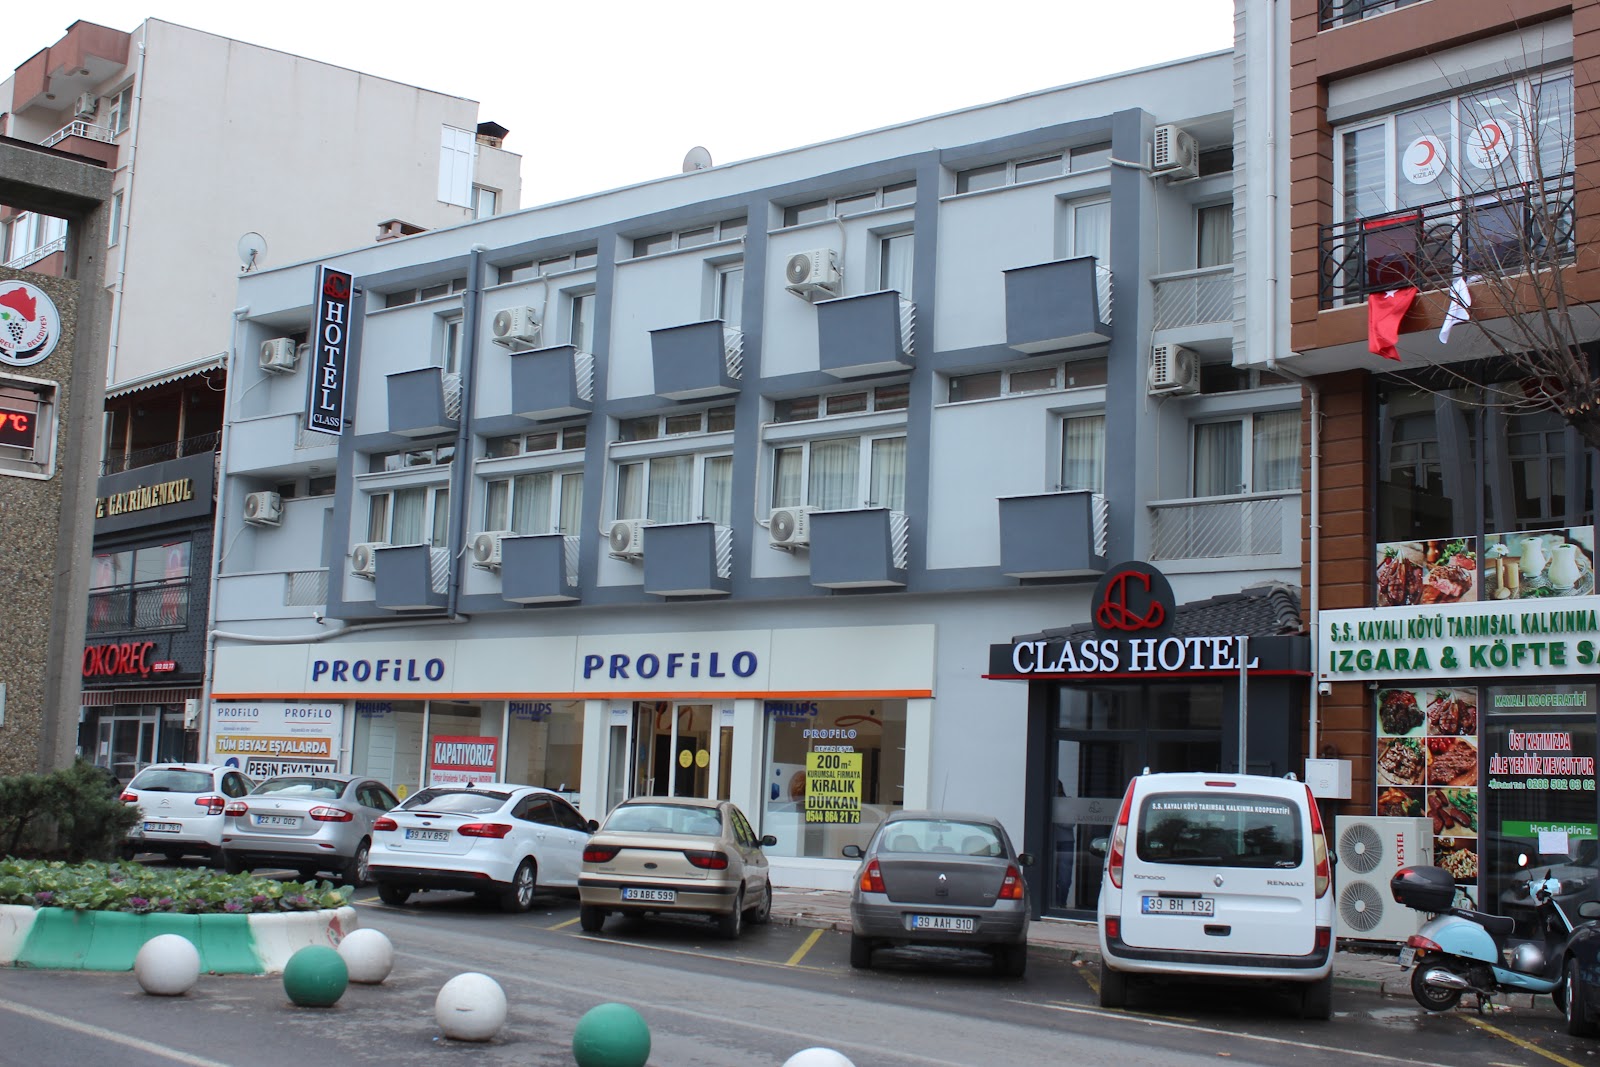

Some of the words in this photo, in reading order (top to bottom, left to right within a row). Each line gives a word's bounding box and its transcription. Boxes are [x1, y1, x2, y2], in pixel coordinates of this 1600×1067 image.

[320, 300, 345, 411] HOTEL
[313, 413, 340, 427] CLASS
[1330, 622, 1354, 642] S.S.
[1358, 619, 1404, 641] KAYALI
[1408, 614, 1443, 639] KÖYÜ
[1447, 614, 1517, 637] TARIMSAL
[1520, 609, 1598, 635] KALKINMA
[82, 641, 154, 678] OKOREÇ
[1012, 640, 1120, 674] CLASS
[1128, 635, 1259, 672] HOTEL
[1330, 647, 1430, 672] IZGARA
[1440, 646, 1458, 669] &
[1470, 639, 1565, 668] KÖFTE
[1576, 639, 1600, 665] S
[1494, 694, 1526, 708] KAYALI
[1527, 691, 1587, 707] KOOPERATİFİ
[218, 736, 236, 751] TÜM
[238, 739, 267, 752] BEYAZ
[269, 741, 328, 757] EŞYALARDA
[1508, 729, 1525, 751] ÜST
[1526, 732, 1571, 751] KATIMIZDA
[434, 742, 495, 767] KAPATIYORUZ
[816, 754, 840, 769] 200
[1489, 753, 1508, 775] AİLE
[1508, 753, 1542, 775] YERİMİZ
[1543, 756, 1594, 776] MEVCUTTUR
[807, 770, 836, 779] KURUMSAL
[1550, 779, 1568, 790] 502
[1582, 779, 1596, 791] 02
[808, 793, 858, 810] DÜKKAN
[806, 810, 822, 822] 0544
[824, 811, 838, 823] 864
[840, 812, 848, 823] 21
[850, 812, 860, 824] 73
[409, 830, 418, 838] 39
[422, 831, 432, 839] AV
[434, 832, 448, 840] 852
[628, 890, 638, 898] 39
[640, 890, 656, 899] ABE
[658, 891, 674, 900] 599
[1149, 899, 1163, 910] 39
[1170, 900, 1184, 910] BH
[1192, 900, 1212, 912] 192
[918, 916, 930, 926] 39
[934, 918, 951, 928] AAH
[956, 918, 972, 930] 910
